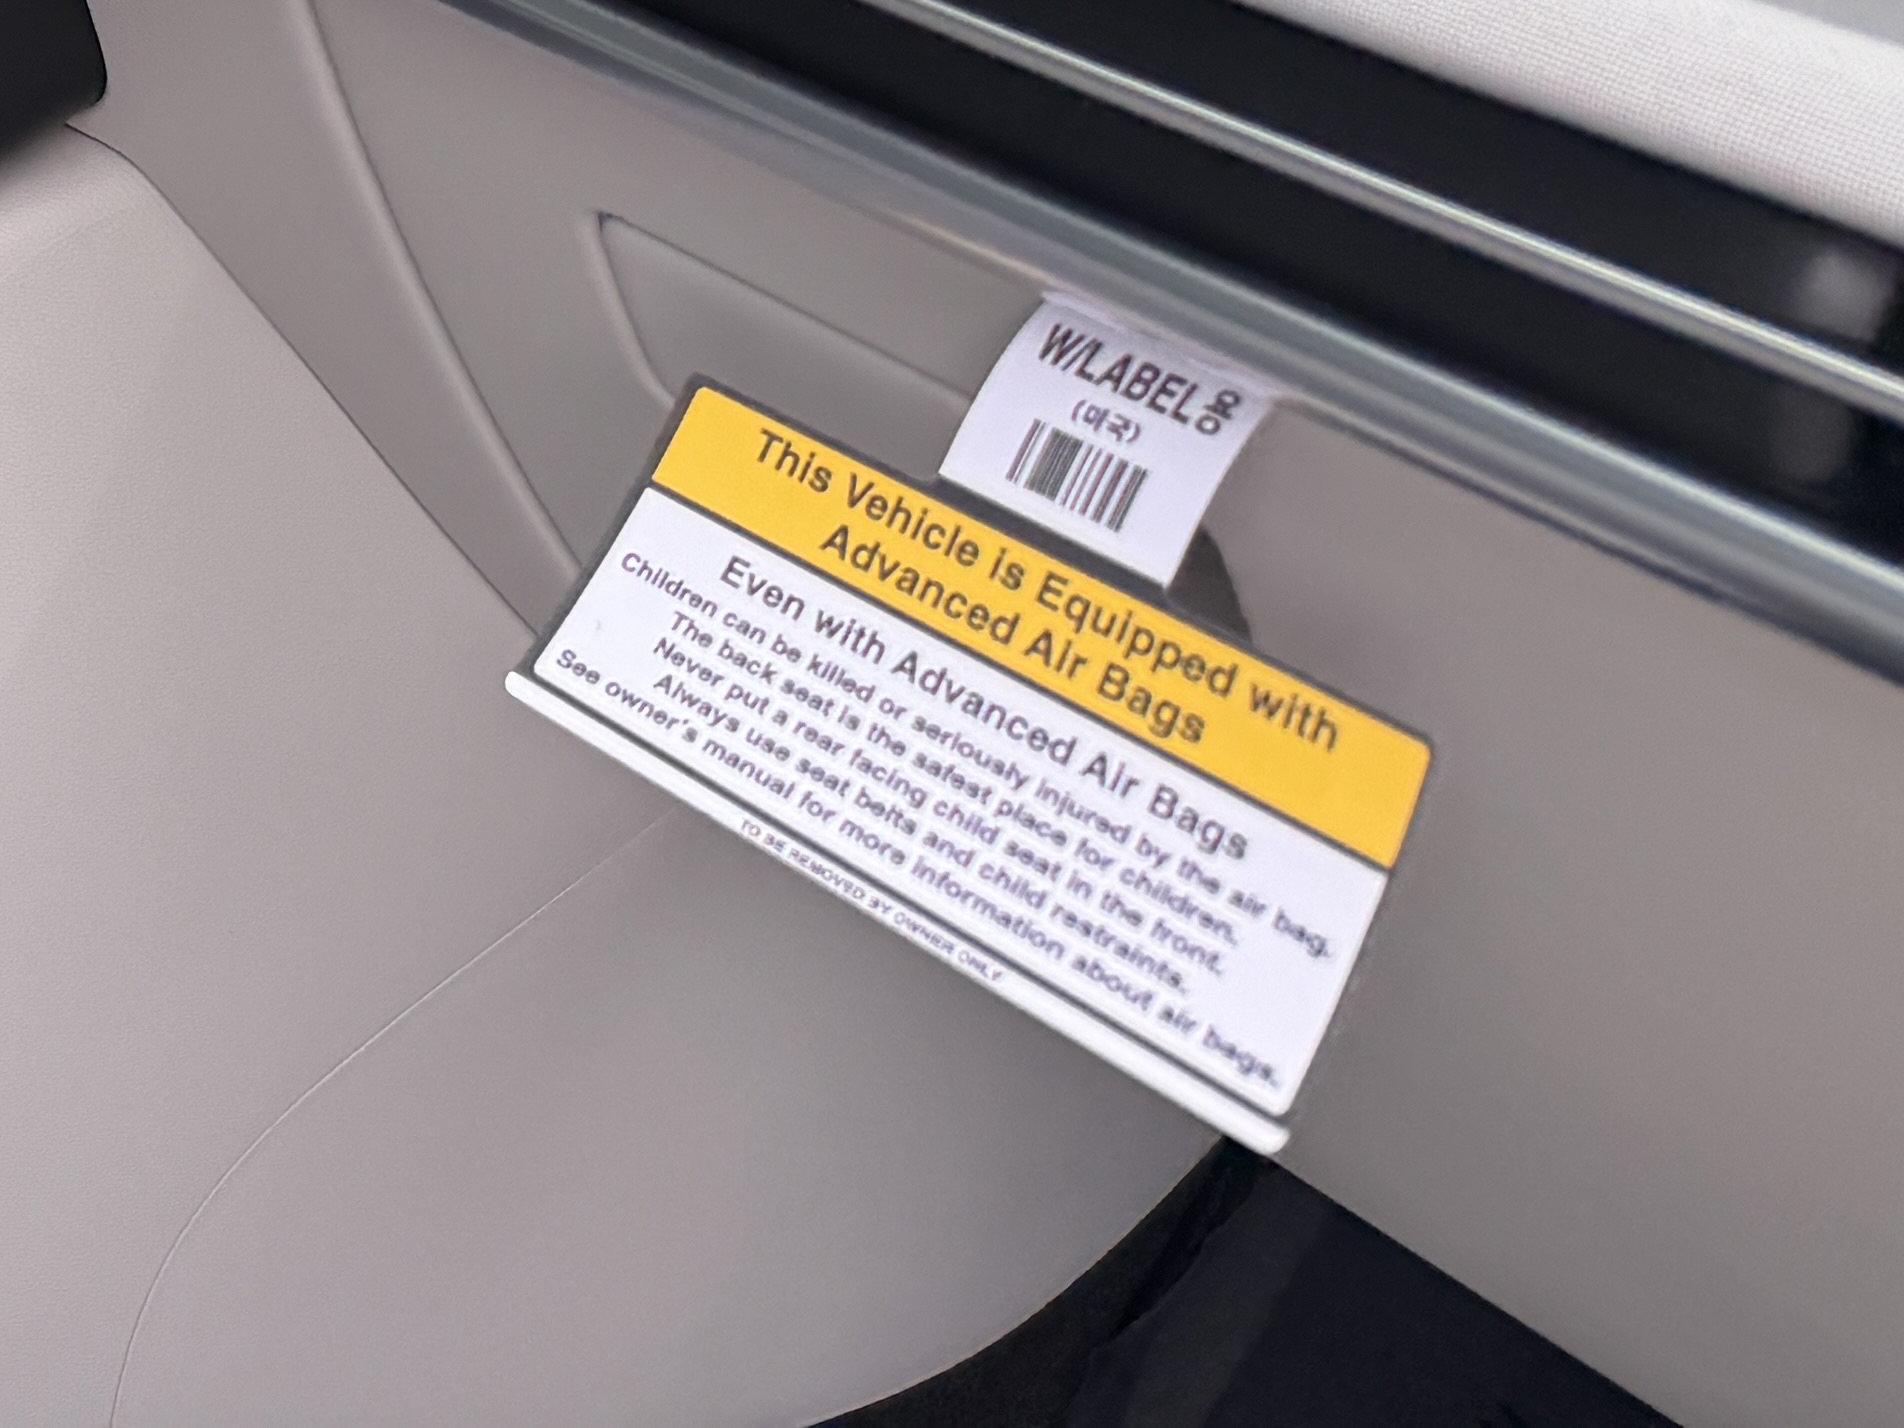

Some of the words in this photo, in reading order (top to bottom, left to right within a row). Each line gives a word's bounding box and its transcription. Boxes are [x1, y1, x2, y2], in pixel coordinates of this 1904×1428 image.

[621, 551, 719, 620] Children
[722, 611, 768, 646] can
[770, 633, 803, 665] be
[807, 650, 878, 704] killed
[878, 695, 908, 722] or
[909, 714, 1032, 793] seriously
[1034, 777, 1133, 845] injured
[1135, 832, 1174, 870] by
[1177, 855, 1222, 896] the
[1226, 890, 1268, 920] air
[719, 554, 807, 622] Even
[814, 608, 887, 666] with
[891, 649, 1079, 767] Advanced
[1080, 749, 1143, 800] Air
[1147, 781, 1249, 861] Bags
[755, 428, 833, 494] This
[845, 470, 981, 569] Vehicle
[988, 548, 1027, 593] is
[1034, 569, 1241, 700] Equipped
[1248, 679, 1341, 754] with
[819, 522, 1022, 646] Advanced
[1024, 627, 1089, 681] Air
[1096, 662, 1209, 745] Bags
[555, 647, 602, 686] See
[603, 679, 700, 745] owner's
[701, 737, 794, 801] manual
[797, 791, 838, 824] for
[839, 817, 908, 866] more
[910, 855, 1067, 961] information
[1071, 954, 1156, 1012] about
[1157, 1004, 1198, 1035] air
[652, 635, 726, 689] Never
[724, 681, 772, 718] put
[770, 707, 790, 728] a
[791, 718, 847, 759] rear
[848, 748, 930, 810] facing
[932, 798, 1002, 846] child
[1002, 838, 1064, 883] seat
[1065, 868, 1094, 900] in
[1099, 889, 1145, 928] the
[652, 672, 742, 734] Always
[744, 726, 793, 763] use
[794, 755, 852, 798] seat
[853, 785, 918, 836] belts
[921, 829, 977, 869] and
[977, 861, 1049, 911] child
[668, 610, 714, 648] The
[716, 639, 779, 686] back
[779, 677, 837, 719] seat
[837, 707, 862, 733] is
[865, 721, 908, 758] the
[911, 750, 994, 807] safest
[993, 798, 1068, 848] place
[1073, 837, 1116, 872] for
[1118, 865, 1240, 947] children.
[741, 819, 762, 838] TO
[762, 833, 788, 853] BE
[789, 846, 866, 901] REMOVED
[893, 911, 956, 955] OWNER
[957, 951, 1005, 982] ONLY
